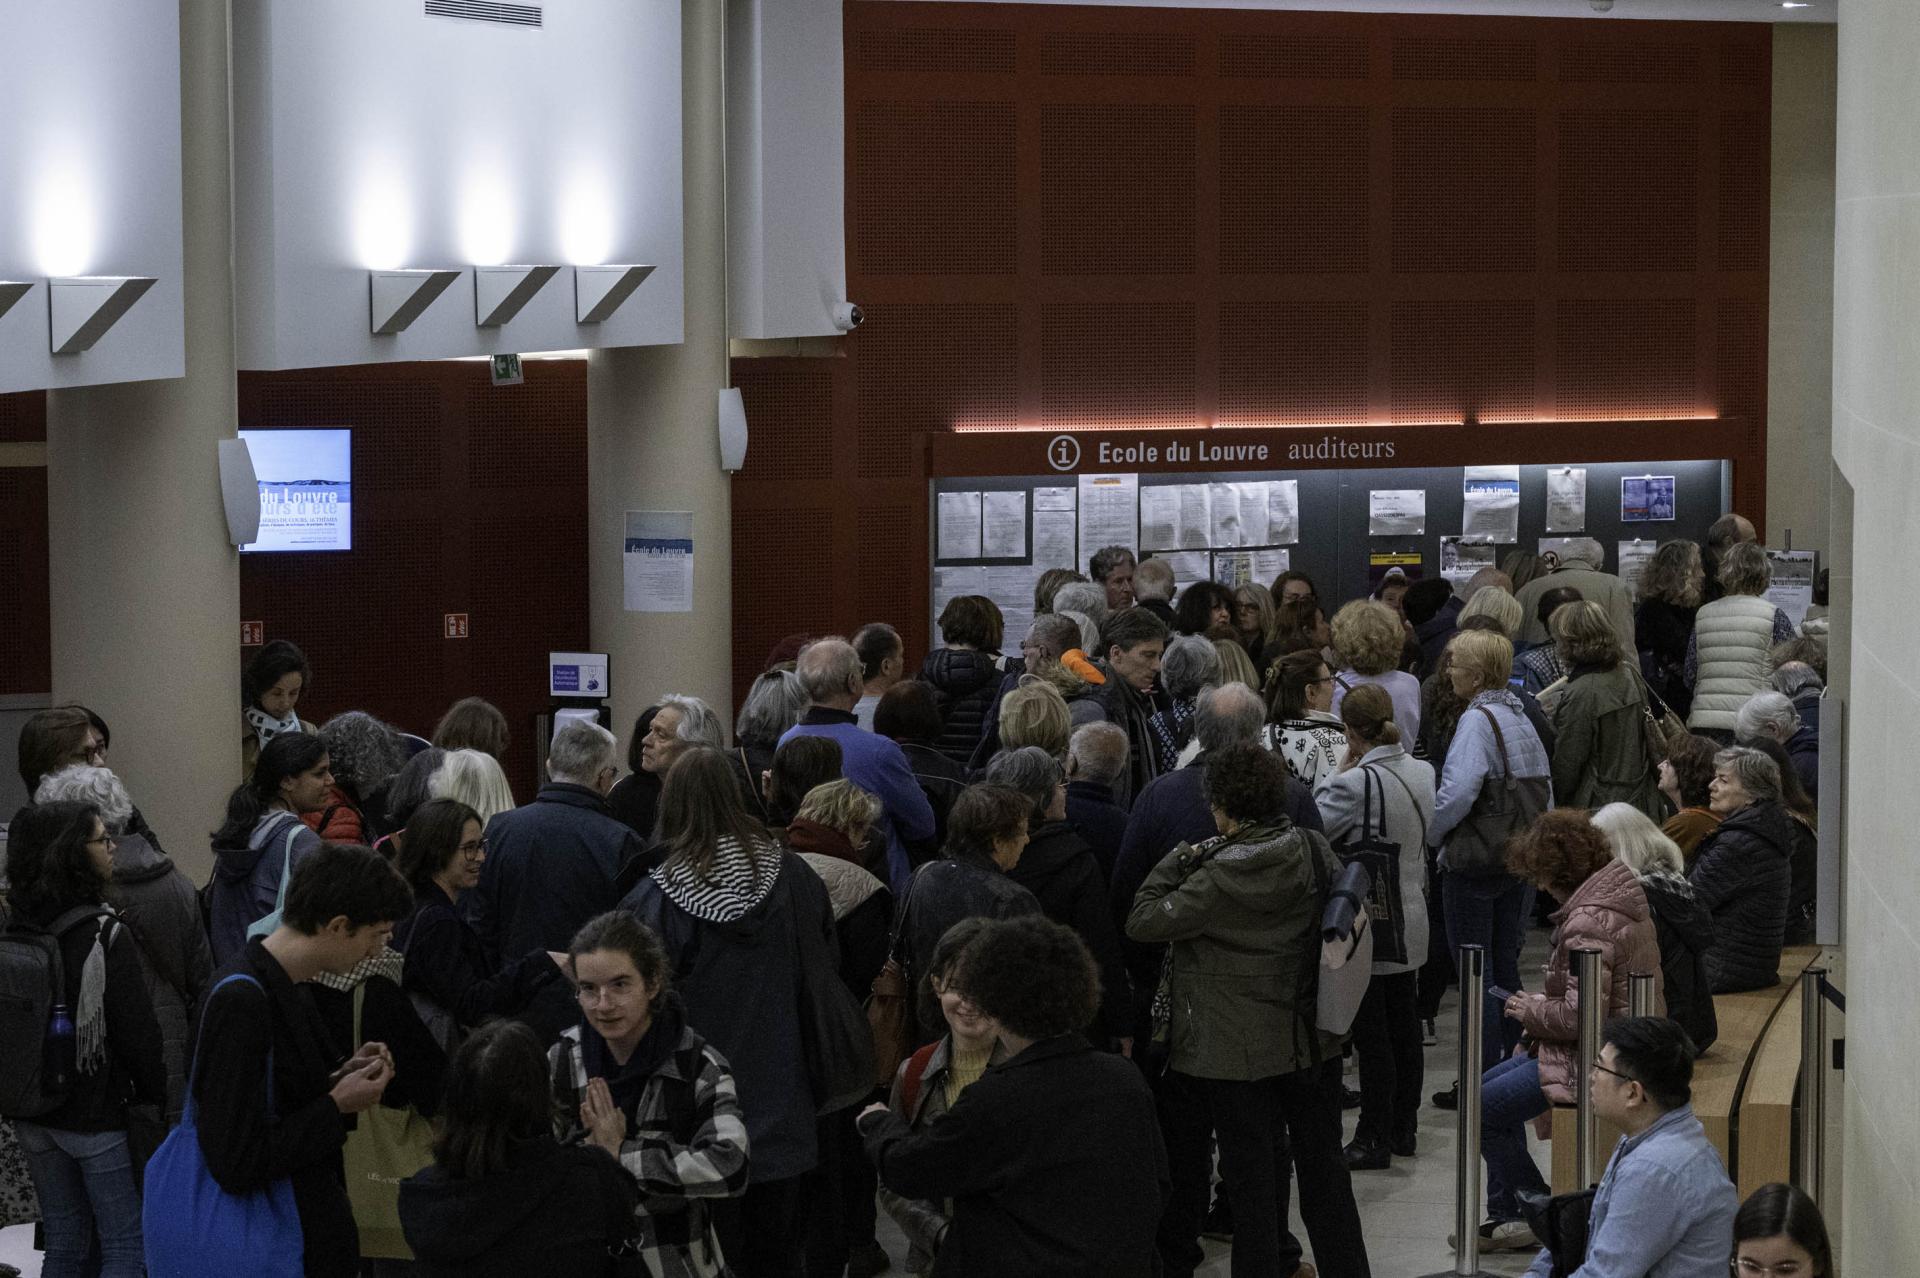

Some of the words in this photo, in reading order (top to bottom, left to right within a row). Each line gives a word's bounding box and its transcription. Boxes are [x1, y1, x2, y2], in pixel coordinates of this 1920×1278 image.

[1099, 441, 1158, 464] Ecole
[1166, 441, 1191, 462] du
[1199, 440, 1269, 462] Louvre
[1288, 436, 1396, 460] auditeurs
[260, 488, 279, 504] du
[284, 487, 338, 504] Louvre
